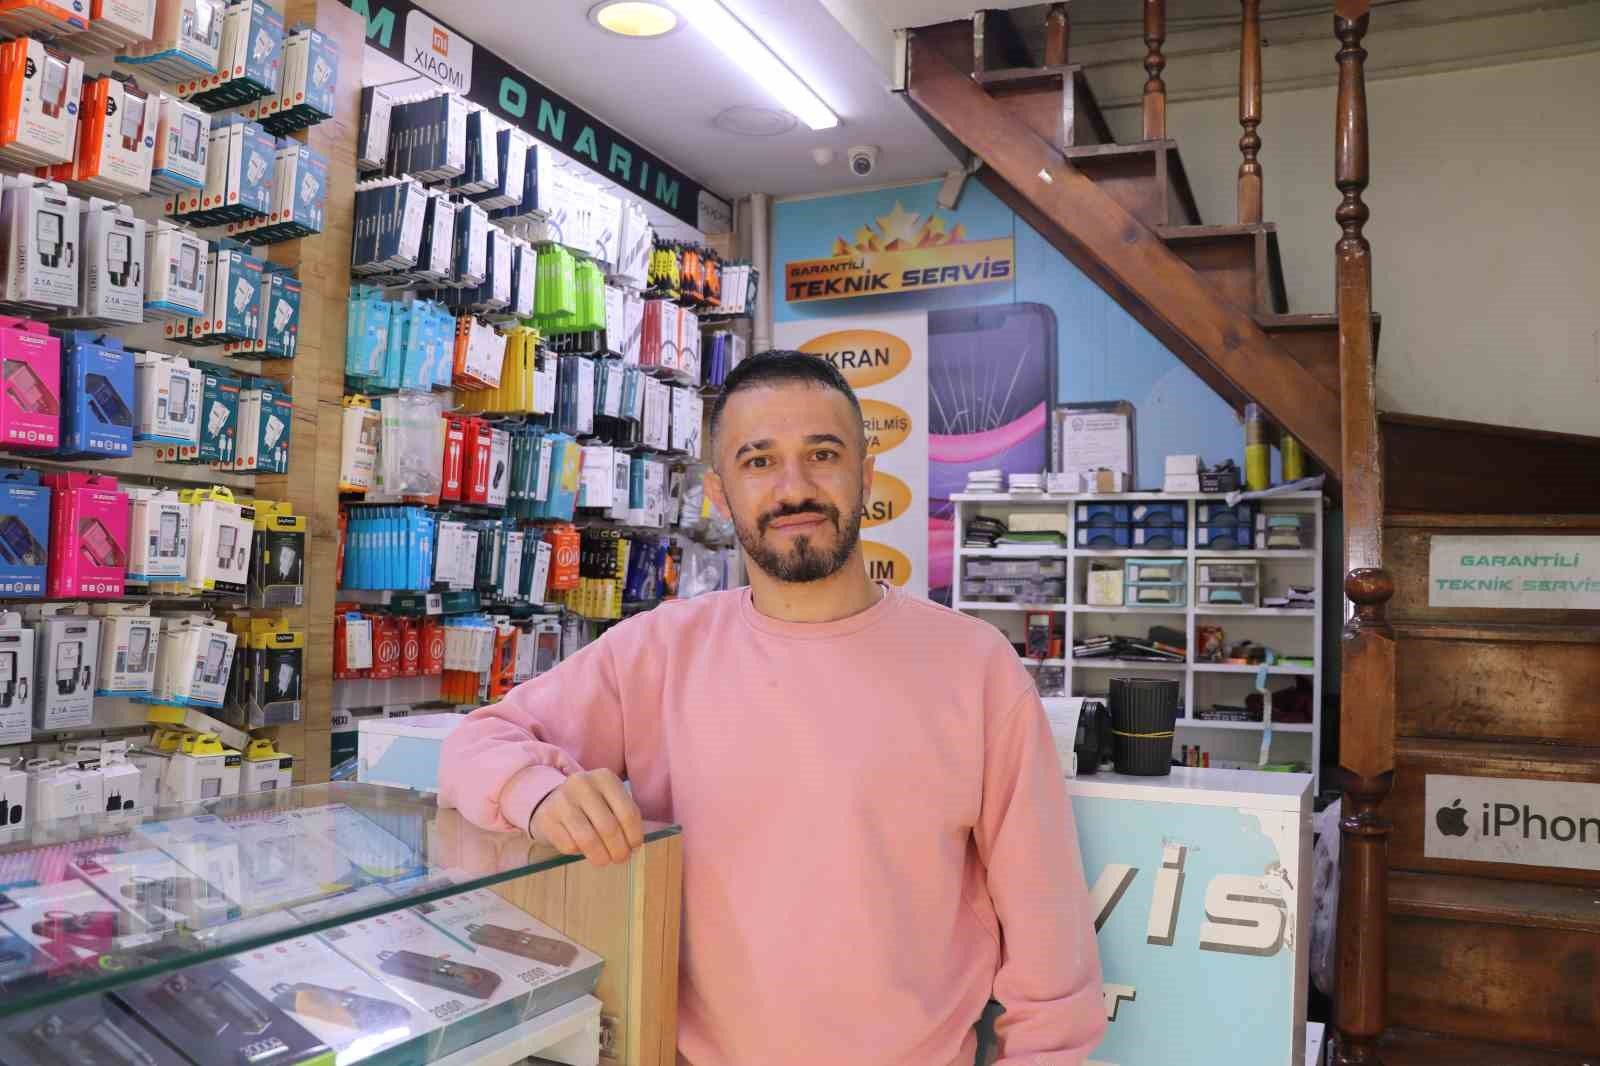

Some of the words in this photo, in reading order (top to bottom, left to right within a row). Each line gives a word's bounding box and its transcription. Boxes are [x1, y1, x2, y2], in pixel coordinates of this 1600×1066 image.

[414, 47, 464, 89] XIAOMI
[498, 76, 681, 210] ONARIM
[790, 269, 891, 298] TEKNİK
[901, 256, 1011, 287] SERVİS
[811, 347, 890, 369] KRAN
[863, 416, 908, 432] RİLMİŞ
[861, 500, 893, 521] ASI
[870, 560, 894, 579] IM
[1460, 553, 1581, 568] GARANTİLİ
[1435, 576, 1513, 591] TEKNİK
[1482, 803, 1600, 843] iPhon
